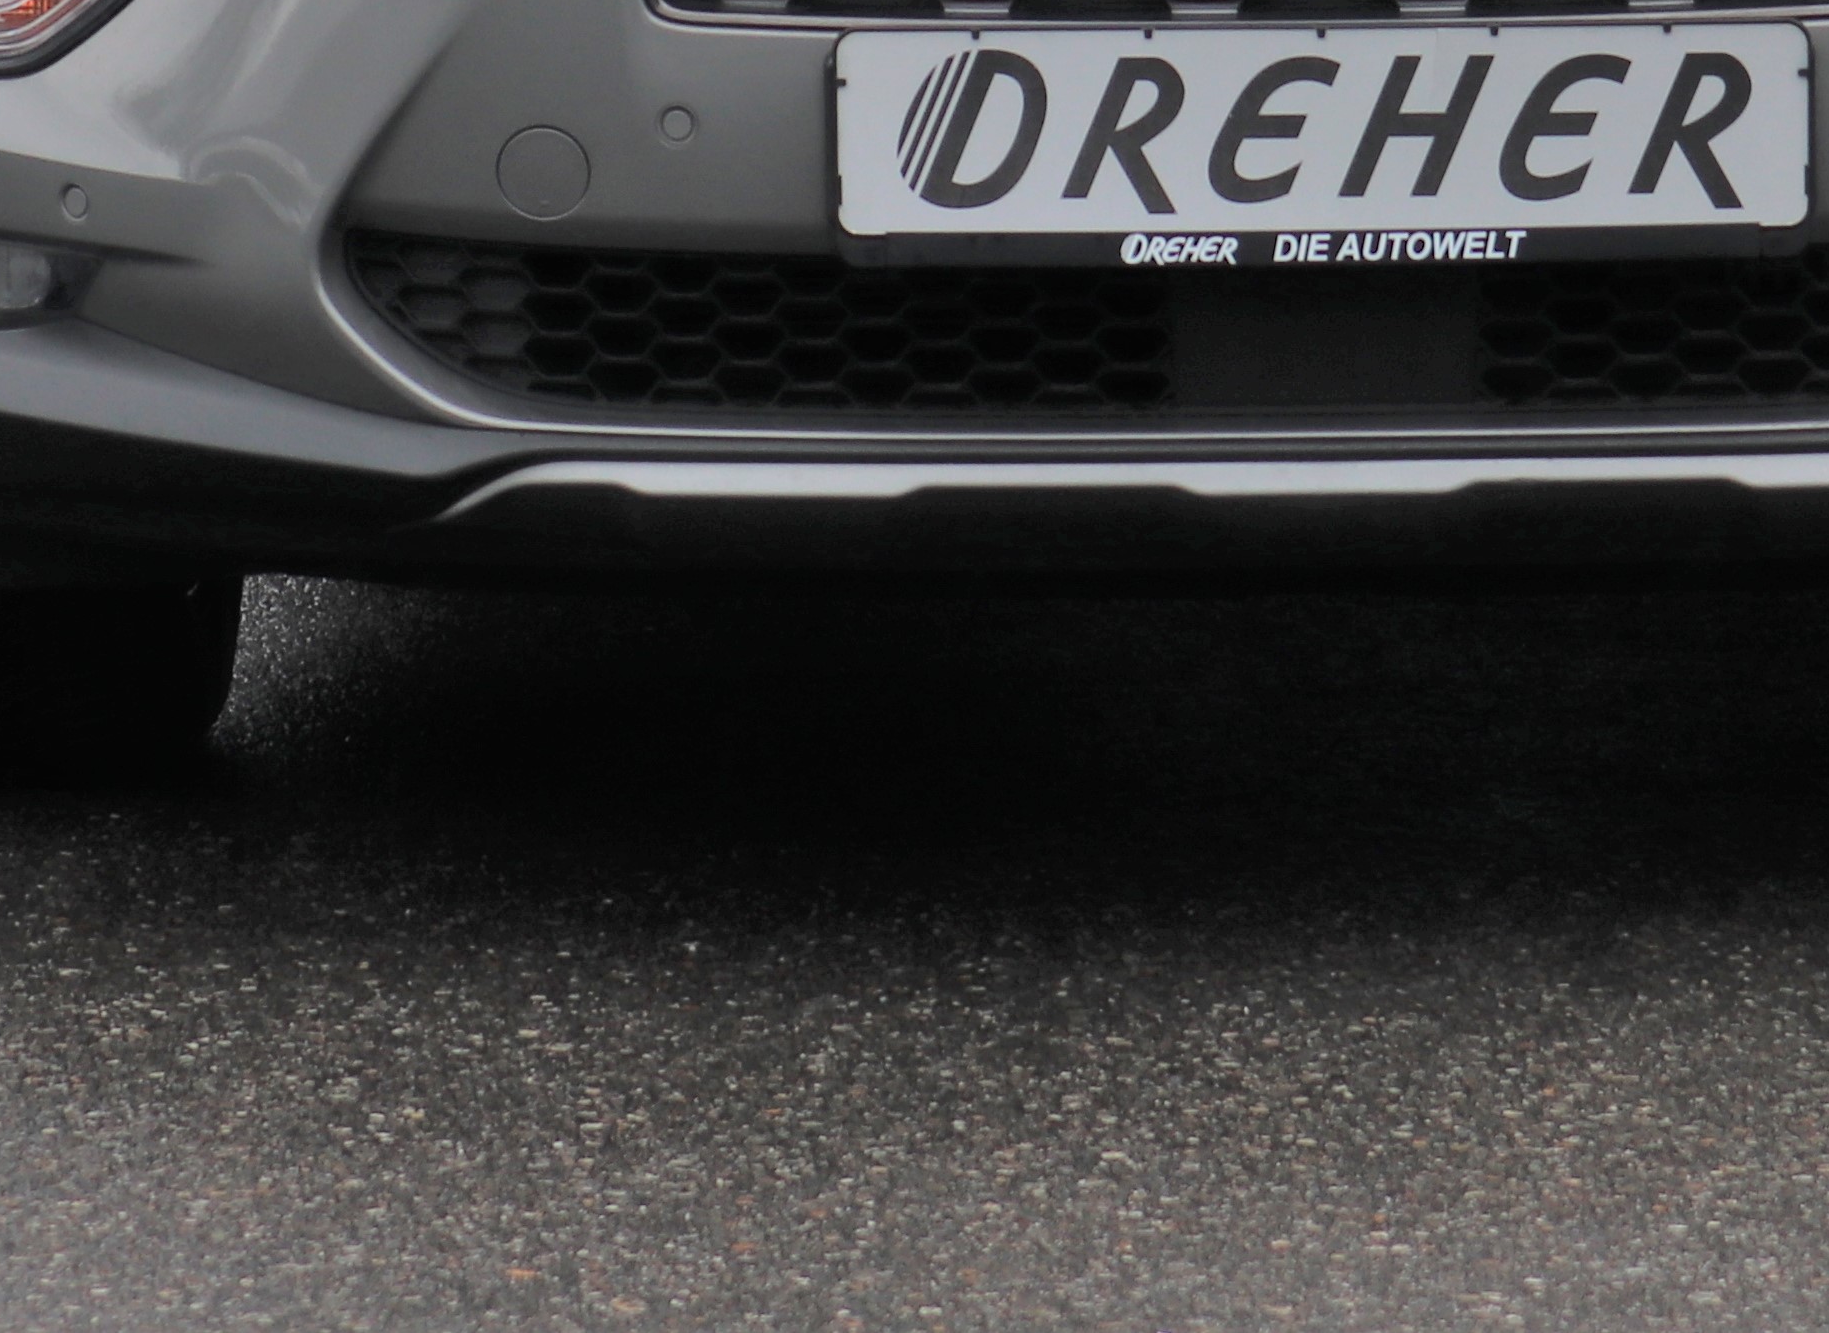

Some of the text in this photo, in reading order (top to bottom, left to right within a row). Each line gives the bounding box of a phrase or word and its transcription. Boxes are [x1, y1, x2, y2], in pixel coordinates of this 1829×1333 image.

[896, 49, 1753, 214] DREHER
[1121, 230, 1528, 266] DREHER DIE AUTOWELT
